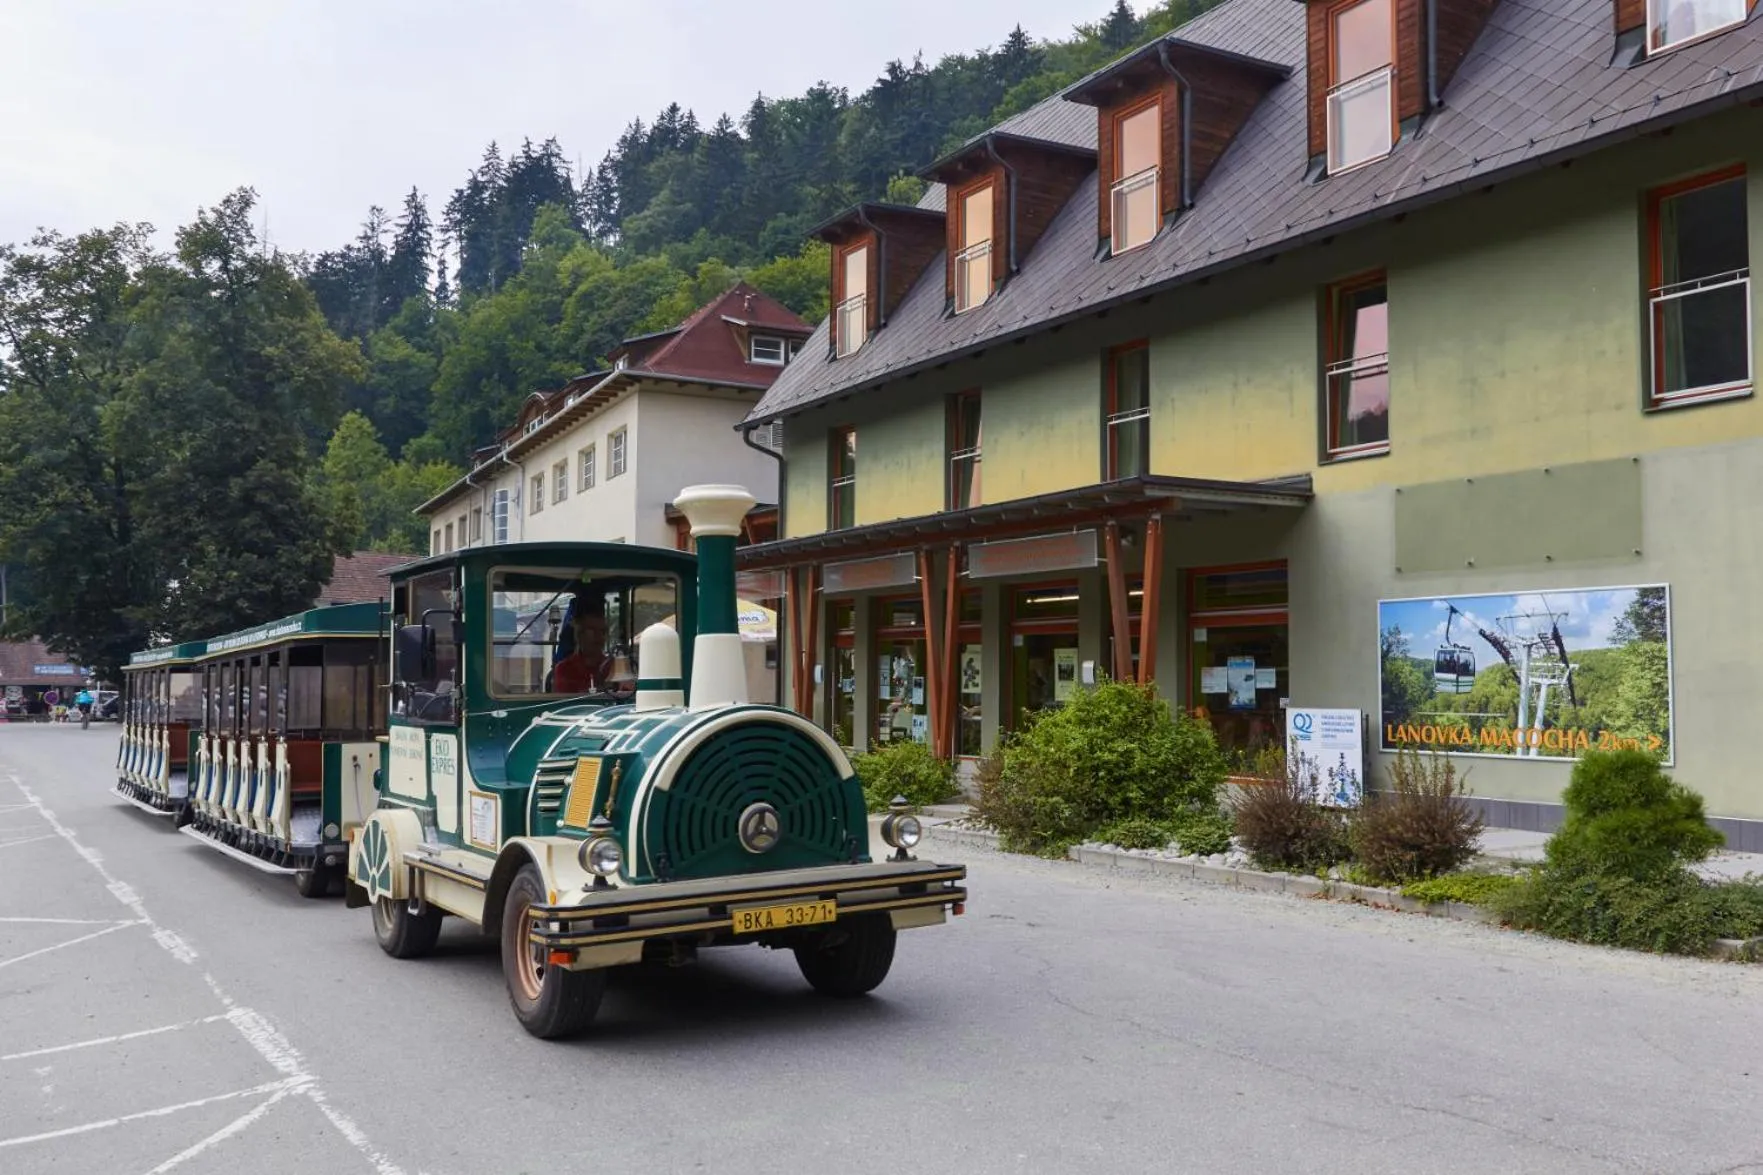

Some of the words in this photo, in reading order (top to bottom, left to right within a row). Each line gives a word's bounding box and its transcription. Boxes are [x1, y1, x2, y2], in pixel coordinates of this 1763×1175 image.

[1387, 724, 1473, 746] LANOVKA
[1480, 727, 1589, 750] MACOCHA
[744, 910, 774, 929] BKA
[785, 904, 826, 924] 33-71
